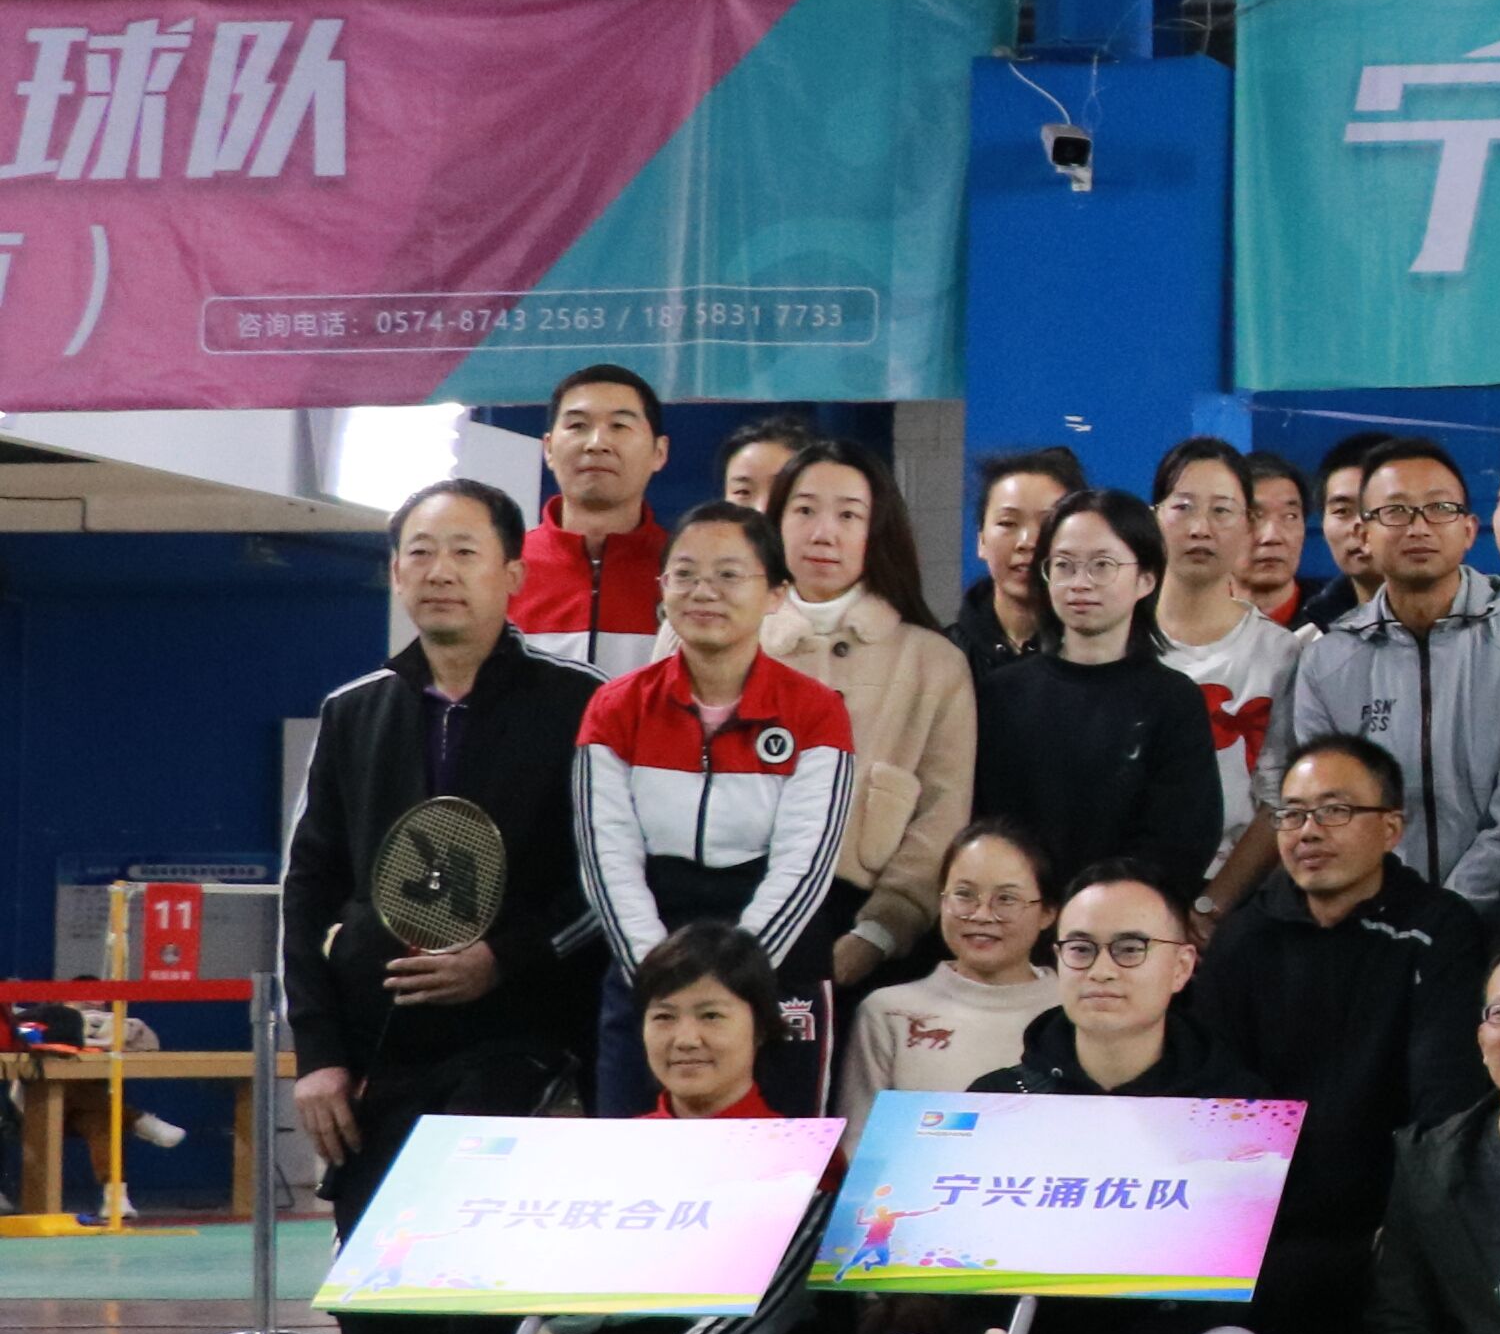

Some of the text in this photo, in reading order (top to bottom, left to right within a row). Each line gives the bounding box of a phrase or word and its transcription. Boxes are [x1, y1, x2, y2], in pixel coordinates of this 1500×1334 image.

[0, 18, 346, 179] 球队
[376, 310, 526, 333] 0574-8743
[538, 307, 606, 330] 2563
[776, 304, 842, 327] 7733
[153, 900, 193, 930] 11
[932, 1174, 1190, 1210] 宁兴涌优队
[457, 1198, 713, 1230] 宁兴联合队
